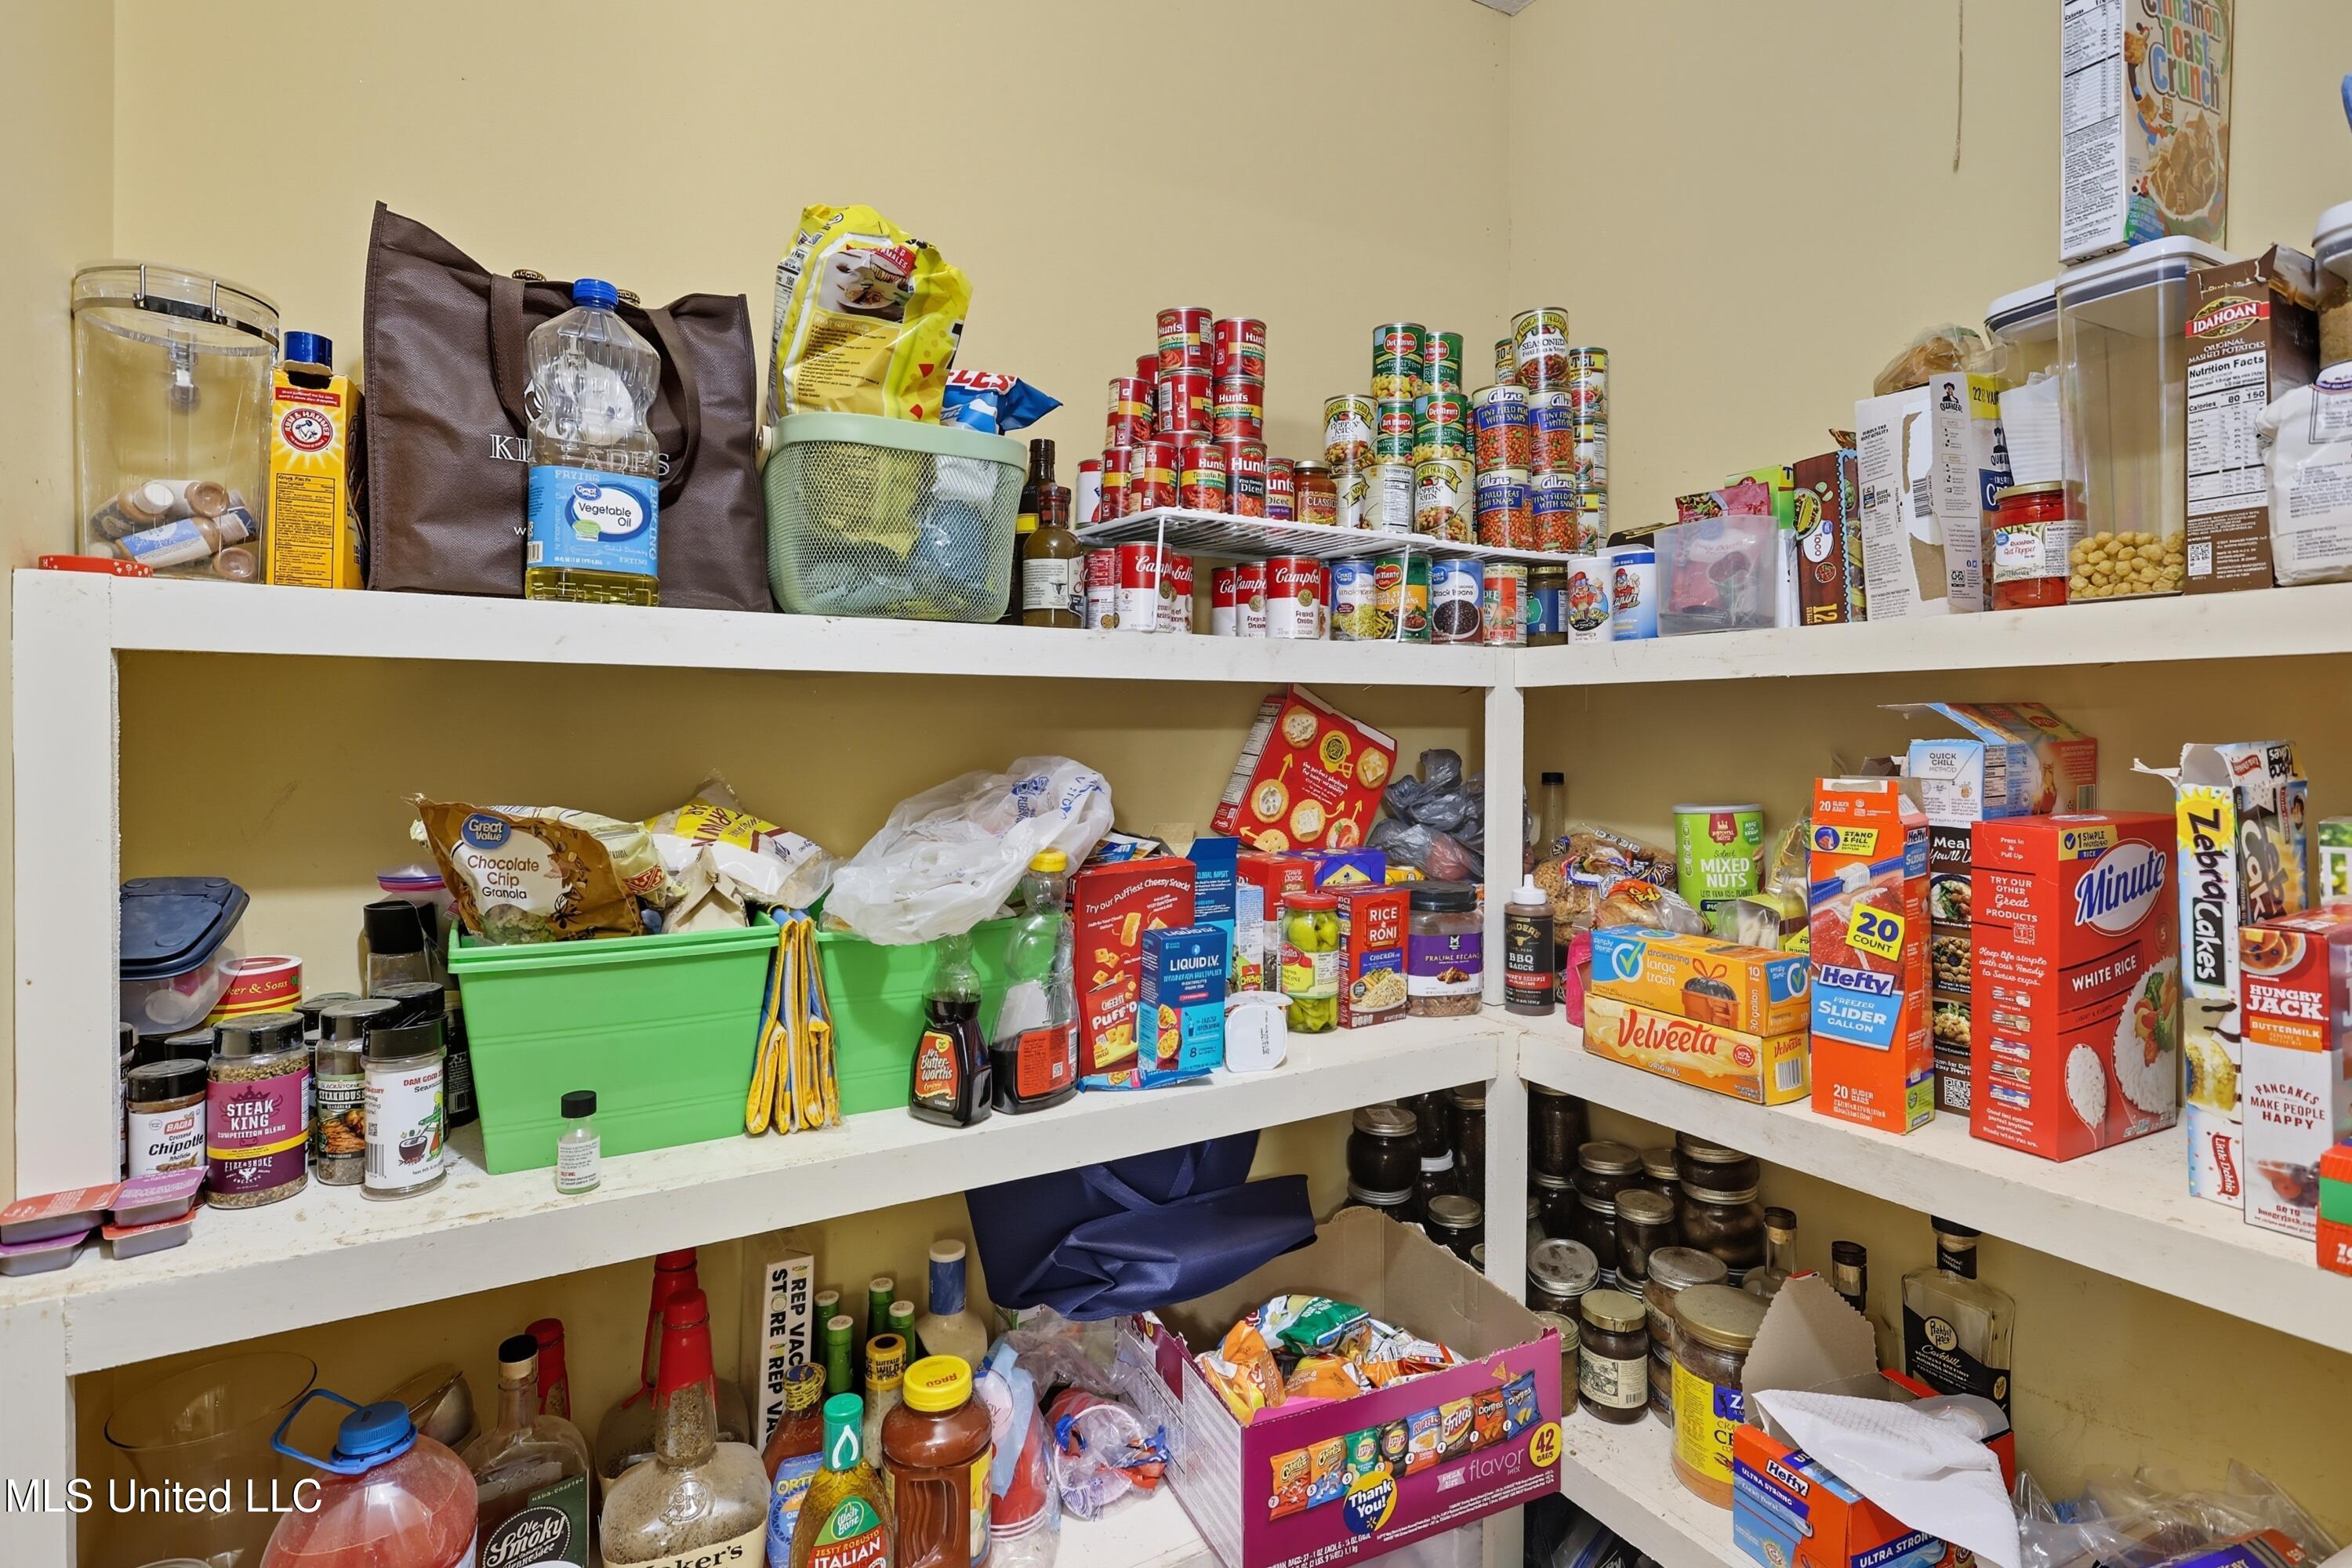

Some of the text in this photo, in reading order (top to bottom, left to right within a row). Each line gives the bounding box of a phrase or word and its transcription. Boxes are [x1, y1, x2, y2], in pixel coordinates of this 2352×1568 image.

[2161, 18, 2210, 70] Toast
[2149, 42, 2220, 114] Crunch
[2193, 303, 2258, 334] IDAHOAN
[2204, 338, 2245, 352] ORIGINAL
[2222, 340, 2266, 357] POTATOES
[2189, 356, 2264, 378] Nutrition Facts
[2189, 390, 2264, 412] Calories 80 150
[1240, 482, 1263, 494] Diced
[579, 503, 632, 517] Vegetable
[618, 517, 632, 528] Oil
[1813, 603, 1838, 623] 12
[1819, 800, 1831, 811] 20
[468, 818, 505, 837] Great
[475, 829, 503, 843] Value
[2001, 837, 2016, 845] Press
[2077, 830, 2105, 847] 1 SIMPLE
[466, 855, 540, 873] Chocolate
[2014, 852, 2024, 861] Up
[2188, 808, 2230, 902] Zebra
[1700, 858, 1750, 873] MIXED
[487, 870, 521, 890] Chip
[1706, 873, 1747, 887] NUTS
[1991, 875, 2032, 888] TRY OUR
[2076, 851, 2165, 924] Minute
[481, 886, 528, 901] Granola
[1086, 904, 1099, 914] Try
[1100, 898, 1112, 910] our
[1145, 878, 1169, 889] Cheesy
[1995, 884, 2026, 895] OTHER
[1994, 894, 2030, 909] Great
[1370, 907, 1397, 921] RICE
[1985, 909, 2038, 923] PRODUCTS
[1369, 926, 1397, 942] RONI
[1856, 910, 1900, 943] 20
[2160, 929, 2166, 941] 5
[1853, 934, 1893, 955] COUNT
[2194, 902, 2222, 980] Cakes
[1170, 955, 1219, 972] LIQUID I.V.
[1509, 953, 1534, 963] BBQ
[1648, 949, 1690, 965] drawstring
[1979, 947, 2047, 966] Keep life simple
[1508, 962, 1534, 971] SAUCE
[1646, 959, 1676, 974] large
[1748, 966, 1760, 977] 10
[1979, 959, 2045, 978] with Ready
[2072, 954, 2137, 992] WHITE RICE
[249, 982, 263, 995] &
[264, 978, 289, 993] Sons
[1647, 971, 1675, 986] trash
[1822, 967, 1890, 995] Hefty
[2017, 975, 2041, 986] cups.
[1834, 996, 1875, 1009] FREEZER
[2249, 983, 2323, 1004] HUNGRY
[1092, 1002, 1138, 1030] PUFF'D
[1749, 989, 1759, 1032] 30 gallon
[1818, 1000, 1887, 1025] SLIDER
[1617, 1008, 1719, 1055] Velveeta
[1828, 1018, 1874, 1033] GALLON
[2251, 1021, 2321, 1039] BUTTERMILK
[1189, 1047, 1197, 1058] 8
[1774, 1036, 1802, 1058] Velveeta
[921, 1054, 949, 1070] Butter-
[1648, 1062, 1680, 1077] ORIGINAL
[404, 1073, 437, 1087] DAM GOOD
[1833, 1084, 1874, 1099] 20 SLIDER
[2255, 1083, 2320, 1105] PANCAKES
[226, 1099, 274, 1117] STEAK
[2250, 1096, 2325, 1120] MAKE PEOPLE
[166, 1120, 193, 1133] BADIA
[230, 1115, 270, 1131] KING
[2262, 1111, 2314, 1130] HAPPY
[217, 1124, 286, 1139] COMPETITION BLEND
[149, 1134, 205, 1156] Chipotle
[2215, 1134, 2230, 1163] Little
[224, 1156, 273, 1172] FIRE SMOKE
[769, 1269, 788, 1338] STORE
[791, 1276, 807, 1316] REP
[768, 1357, 784, 1396] REP
[876, 1365, 900, 1374] WILD
[877, 1371, 898, 1380] WINGS
[1508, 1387, 1533, 1405] Doritos
[1479, 1400, 1504, 1416] Doritos
[1443, 1406, 1472, 1436] Fritos
[1536, 1428, 1555, 1453] 42
[1469, 1448, 1524, 1482] flavor
[1537, 1451, 1554, 1463] BAGS
[1741, 1467, 1793, 1506] ULTRA STRONG
[1768, 1462, 1809, 1494] Hefty
[1348, 1479, 1393, 1508] Thank
[1357, 1497, 1387, 1518] You!
[837, 1508, 858, 1526] Wish
[516, 1521, 538, 1539] Ole
[838, 1517, 860, 1536] Bone
[487, 1515, 564, 1566] Smoky
[815, 1530, 880, 1556] ZESTY ROBUSTO
[815, 1537, 880, 1568] ITALIAN
[1860, 1548, 1893, 1568] ULTRA
